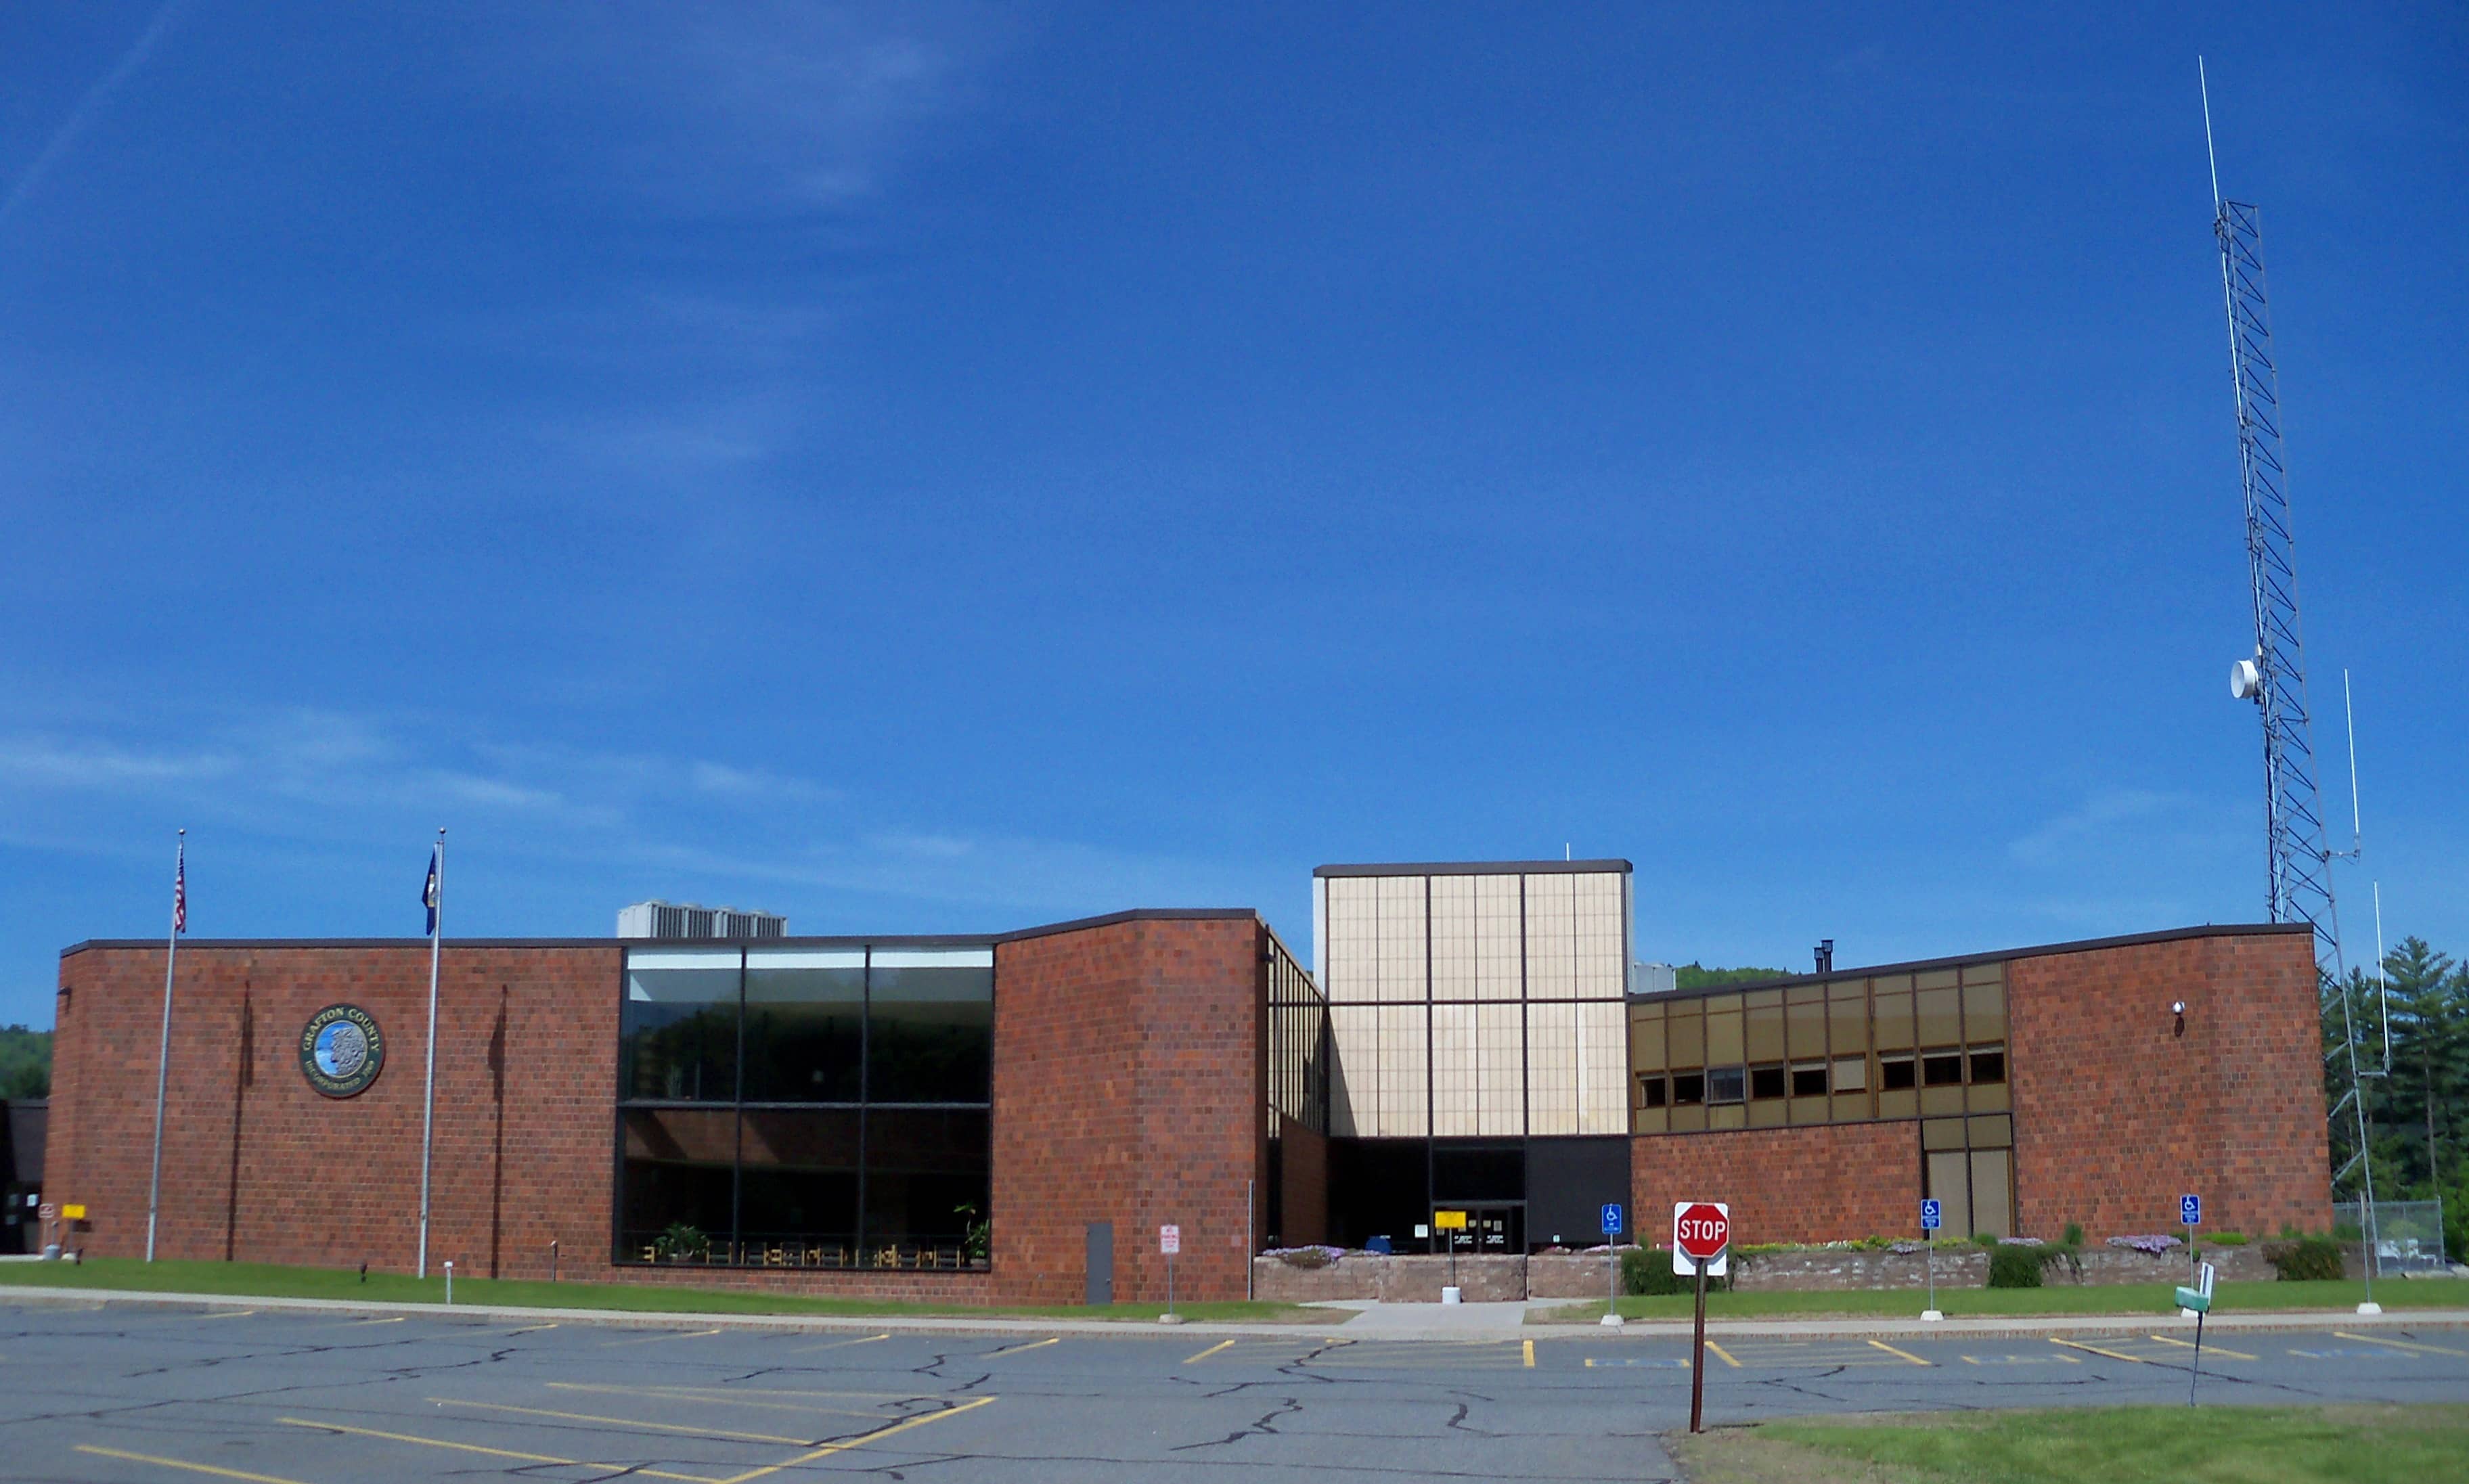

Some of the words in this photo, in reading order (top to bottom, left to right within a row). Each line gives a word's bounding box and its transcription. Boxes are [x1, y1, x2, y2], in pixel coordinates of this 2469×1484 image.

[303, 1007, 344, 1052] GRAFTON
[347, 1008, 380, 1052] COUNTY
[1679, 1219, 1726, 1241] STOP
